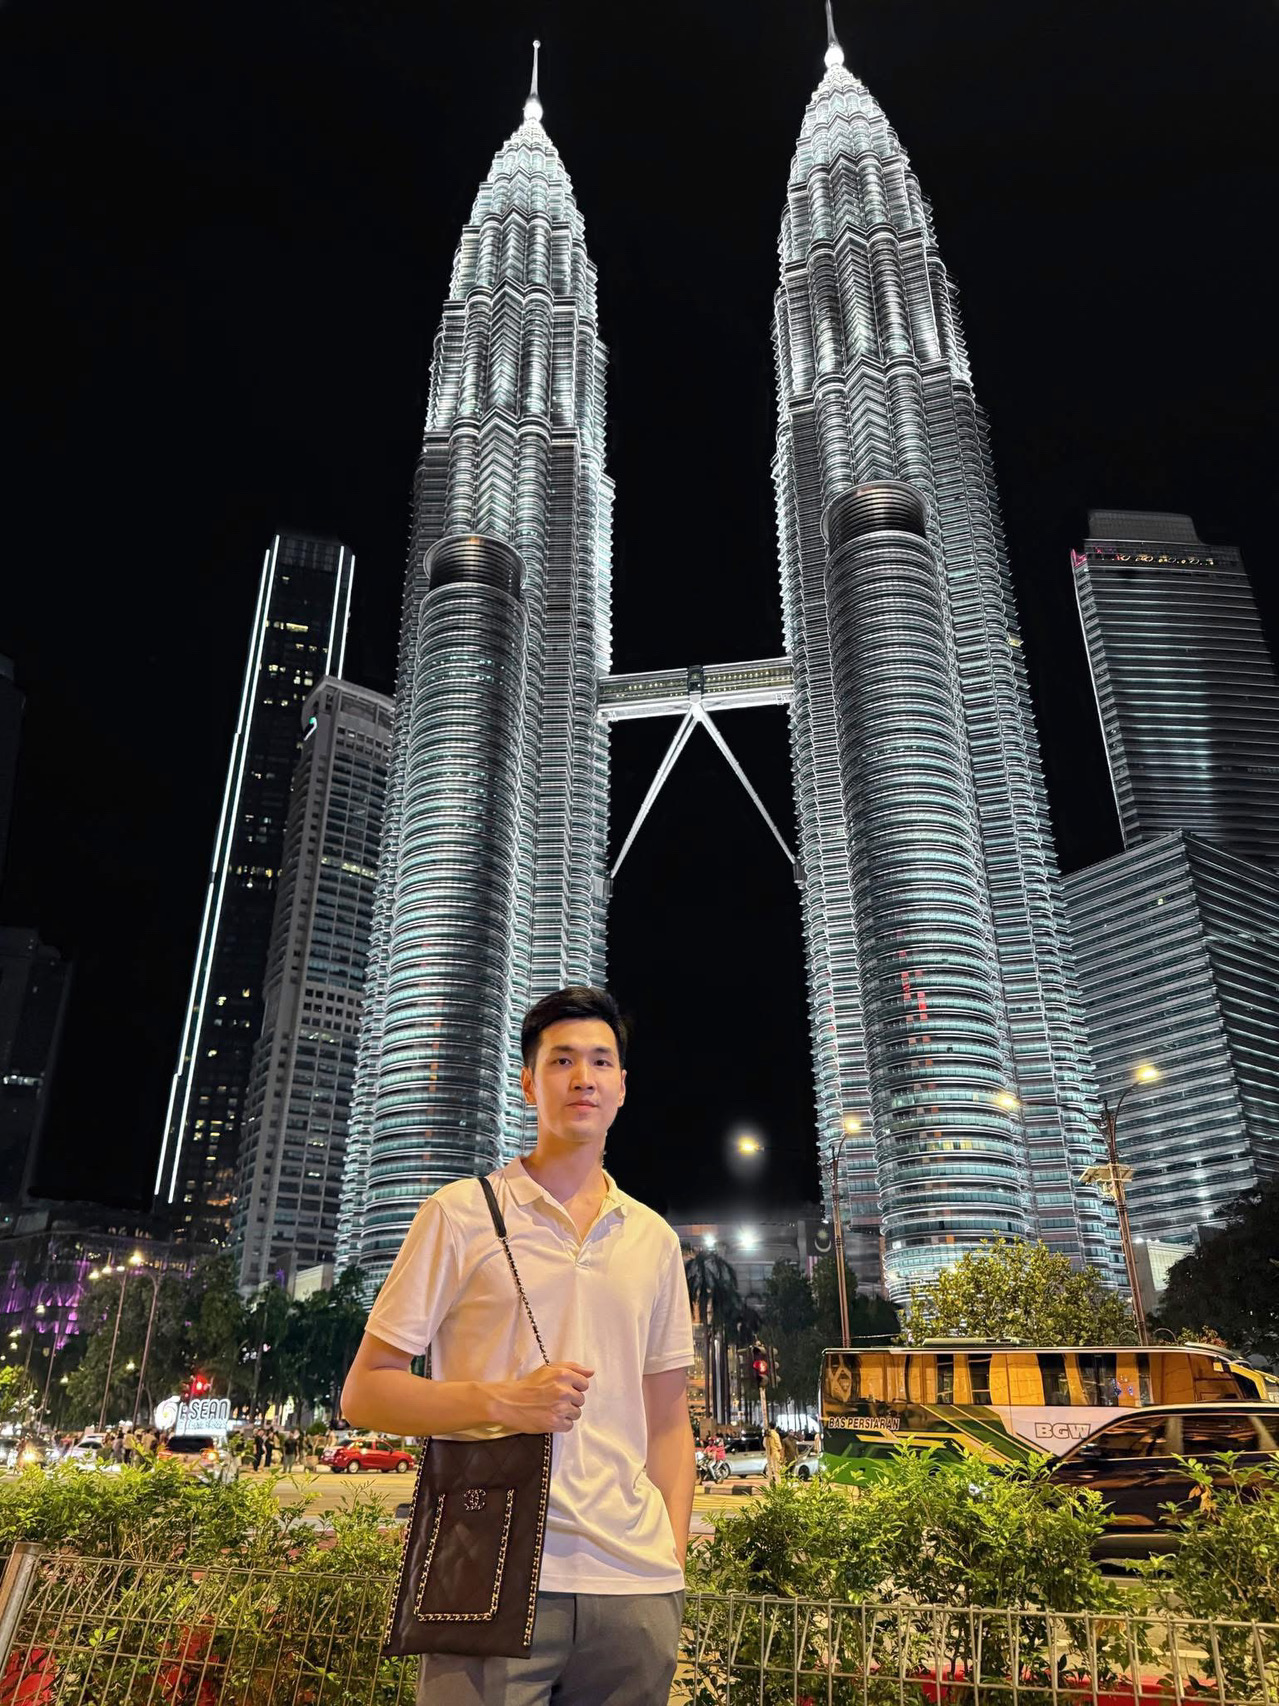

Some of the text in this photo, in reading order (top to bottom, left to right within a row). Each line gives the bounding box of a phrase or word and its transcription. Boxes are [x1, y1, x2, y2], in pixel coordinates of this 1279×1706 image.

[179, 1400, 229, 1420] ASEAN
[828, 1416, 900, 1430] BAS PERSIARAN
[1034, 1422, 1091, 1439] BGW
